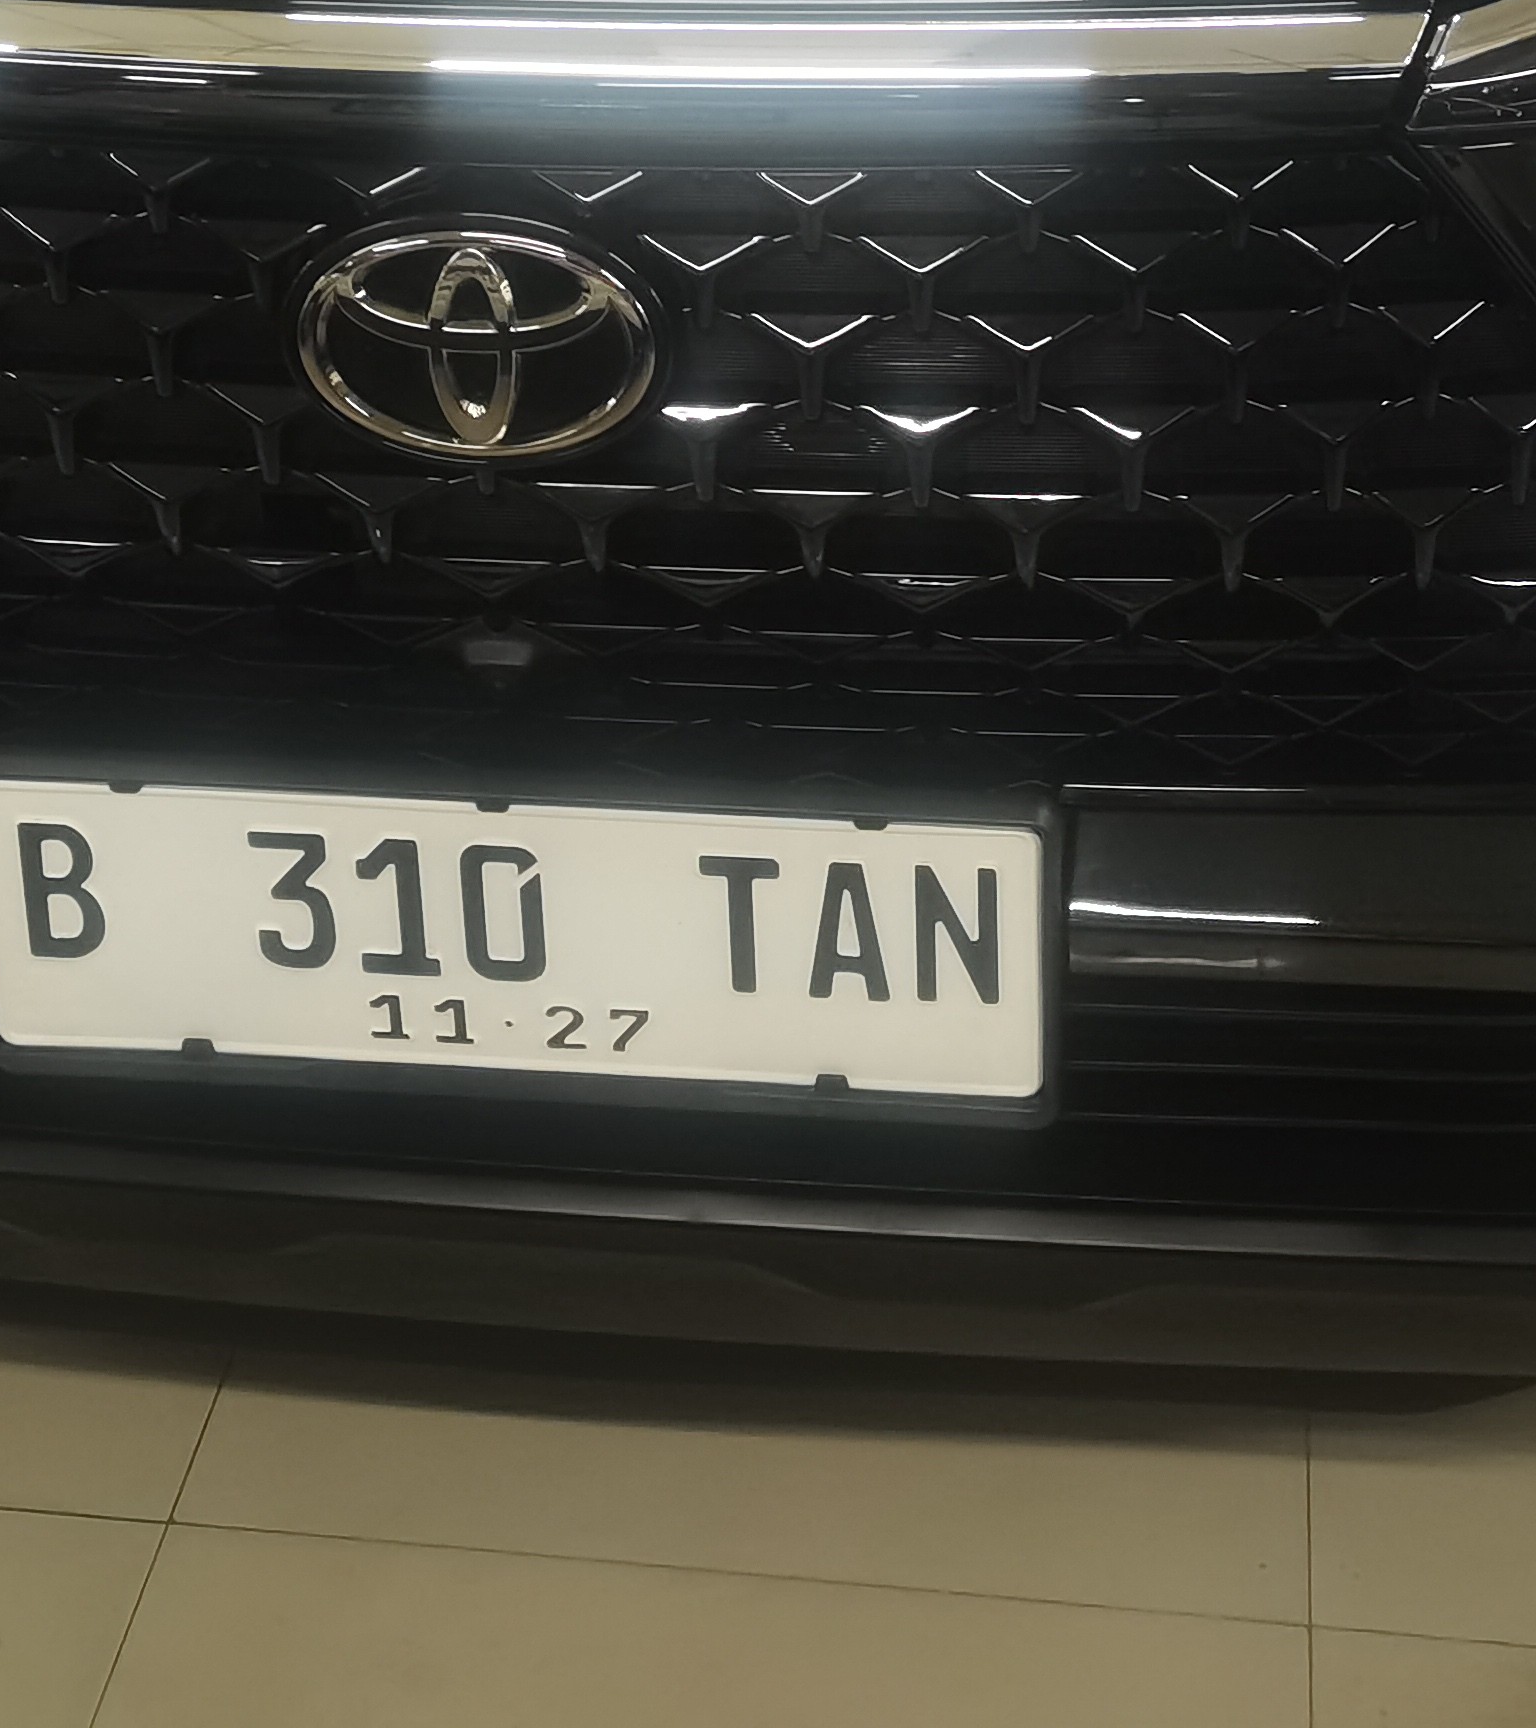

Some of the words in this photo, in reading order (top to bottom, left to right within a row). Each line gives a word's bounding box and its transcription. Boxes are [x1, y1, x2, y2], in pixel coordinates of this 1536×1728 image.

[15, 821, 107, 959] B
[247, 831, 547, 983] 310
[698, 854, 1001, 1005] TAN
